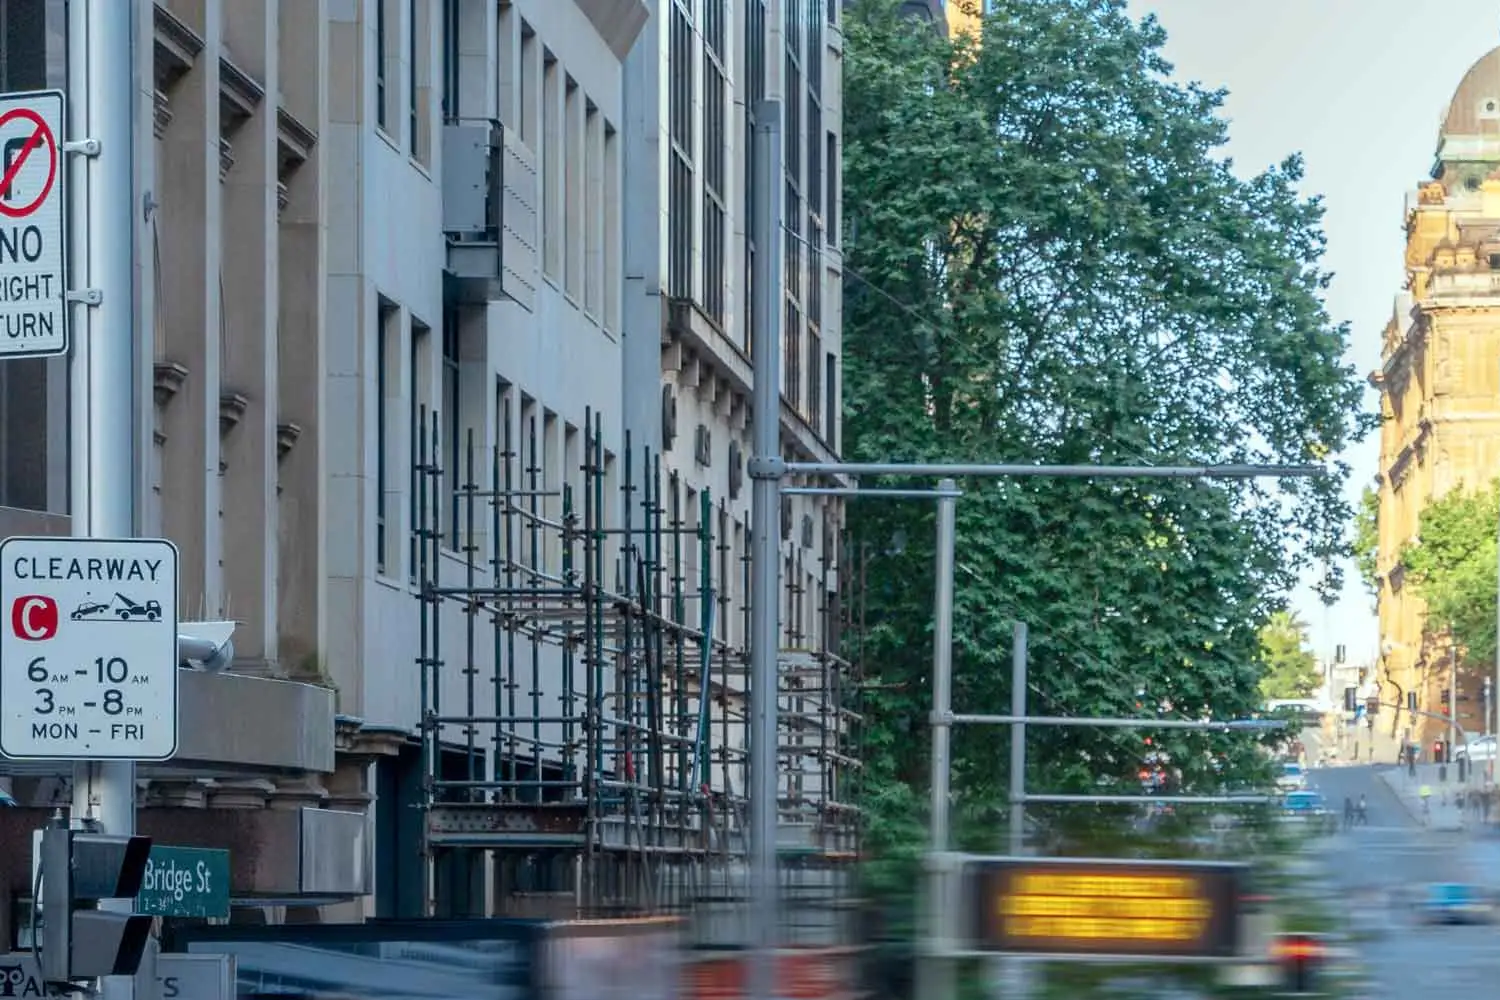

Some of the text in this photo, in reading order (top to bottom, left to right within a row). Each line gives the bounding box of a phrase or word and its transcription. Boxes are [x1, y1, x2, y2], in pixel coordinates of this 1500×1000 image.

[0, 225, 42, 264] NO
[0, 274, 53, 301] IGHT
[15, 557, 162, 581] CLEARWAY
[22, 599, 48, 640] C
[32, 723, 78, 740] MON
[112, 724, 144, 741] FRI
[144, 858, 211, 901] Bridge St
